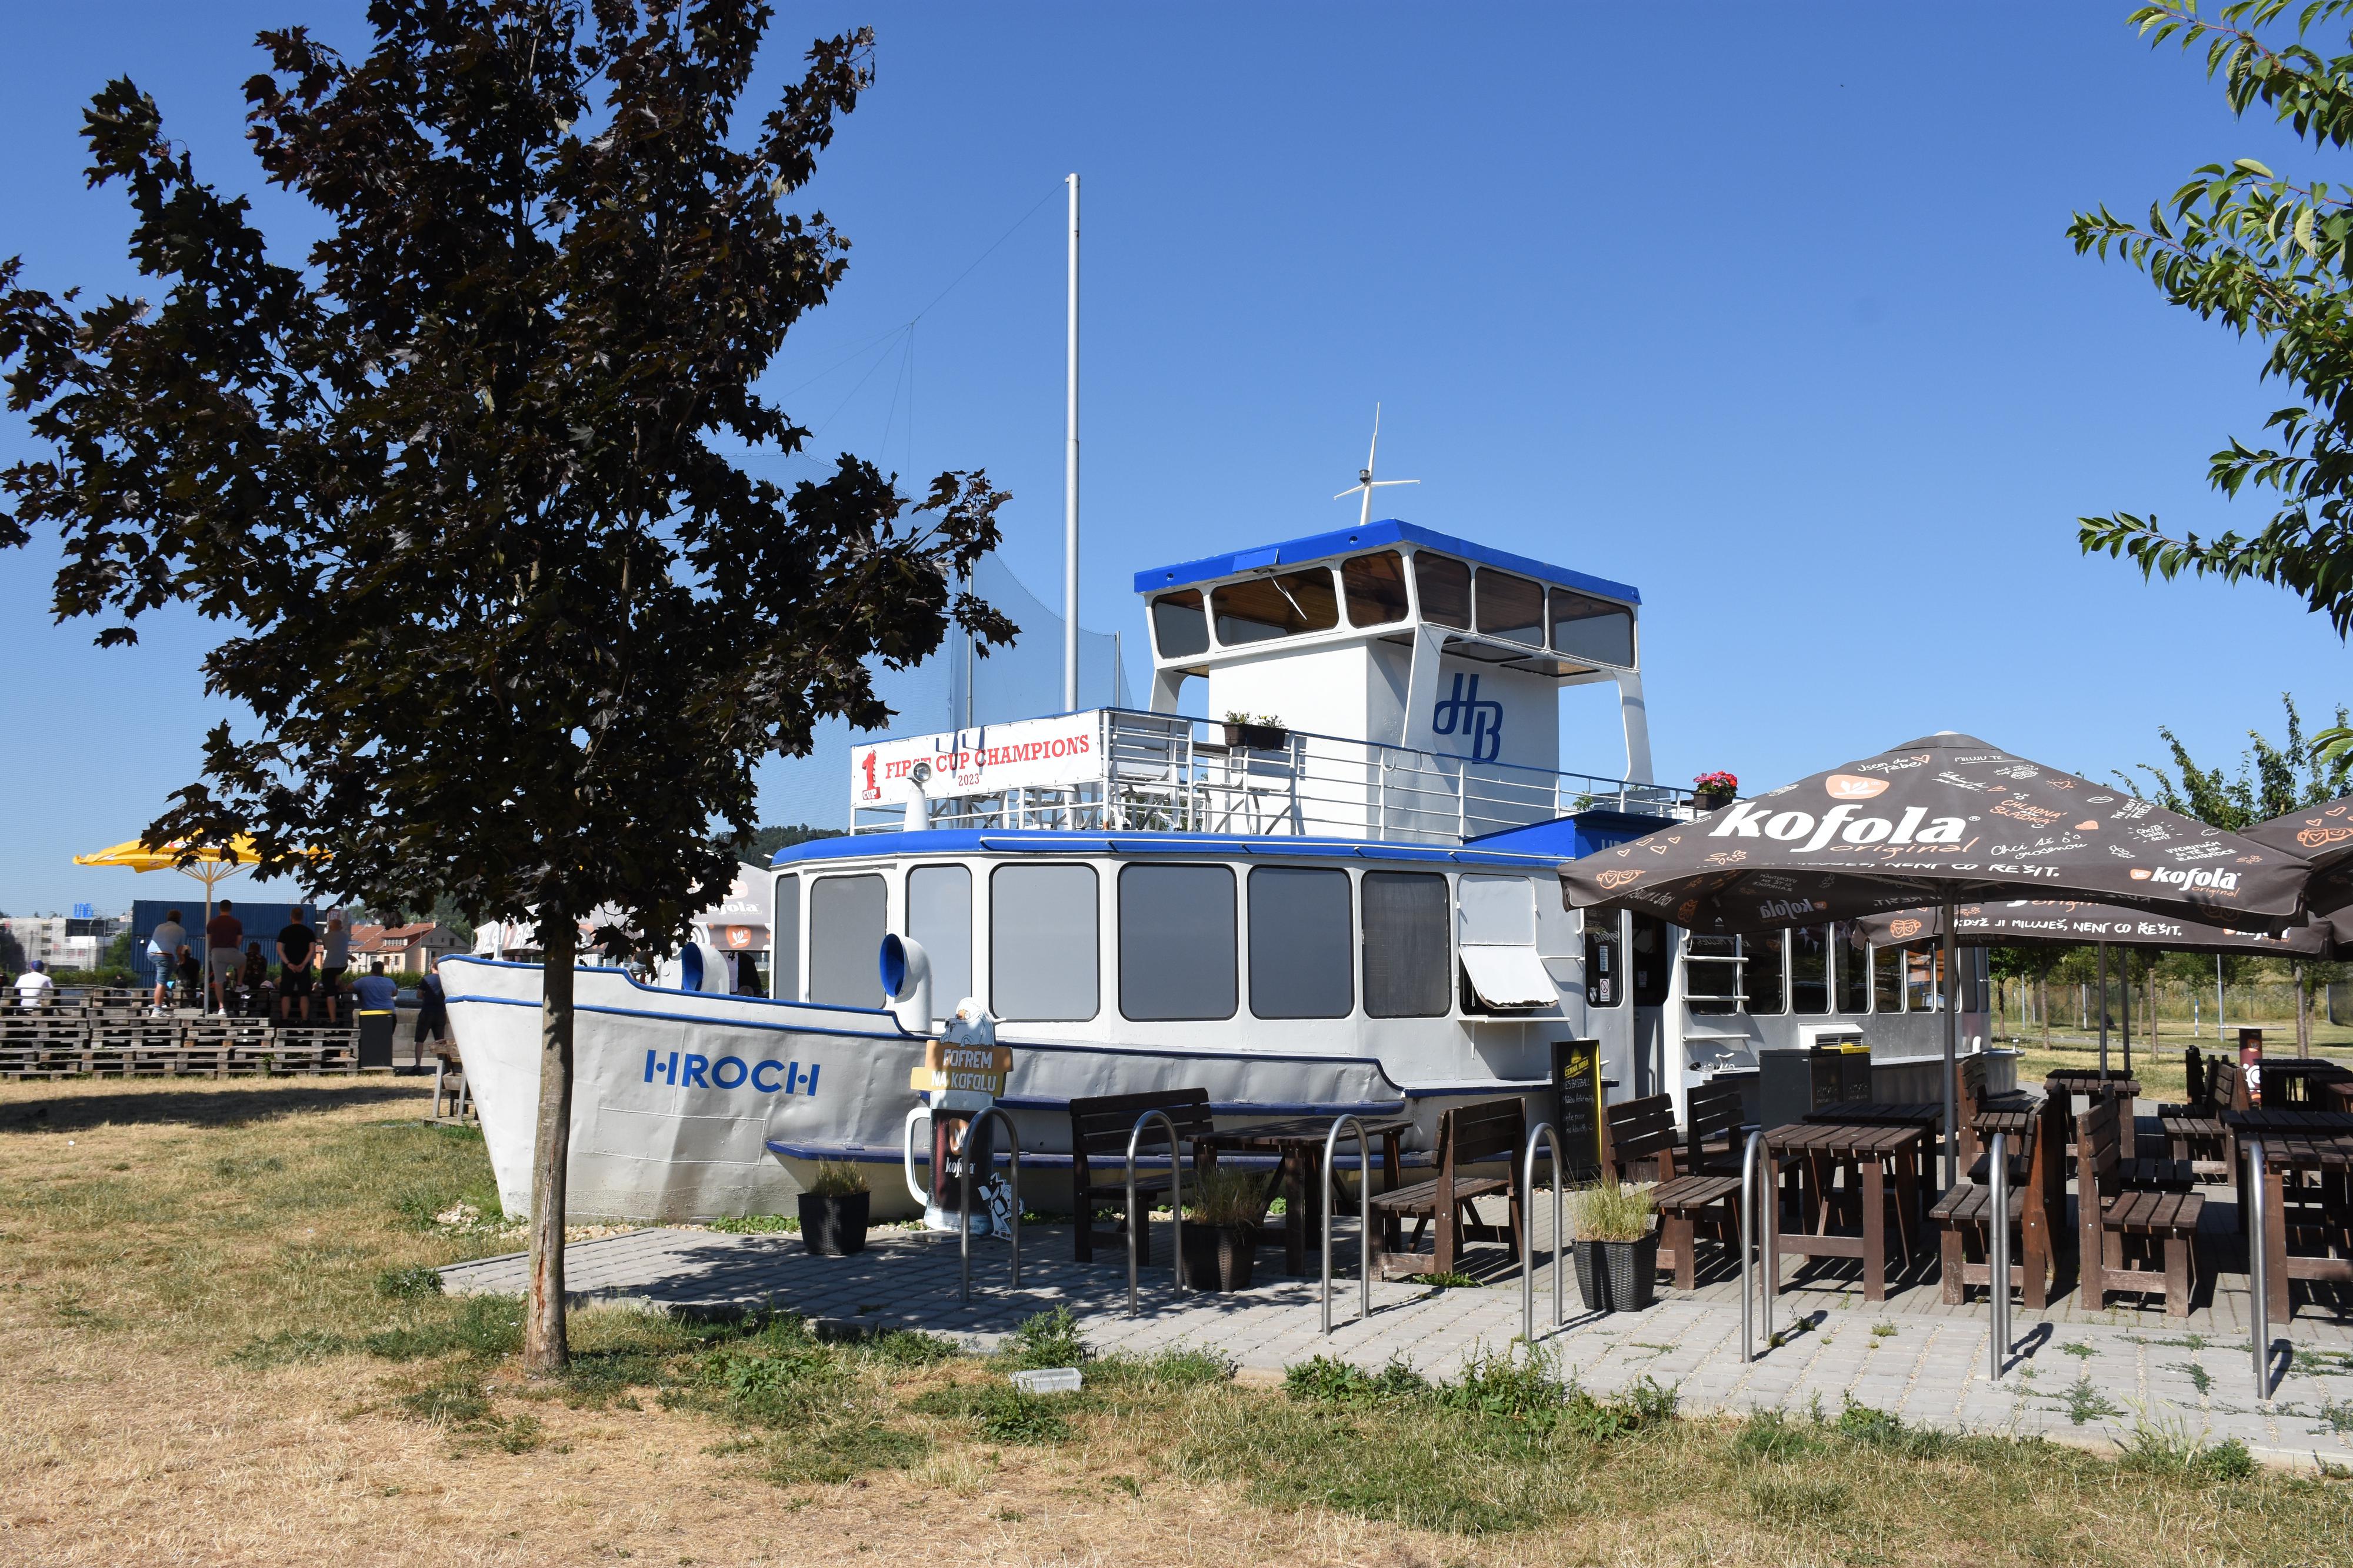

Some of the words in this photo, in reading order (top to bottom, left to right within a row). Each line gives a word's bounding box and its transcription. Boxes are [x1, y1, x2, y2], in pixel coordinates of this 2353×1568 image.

[936, 752, 969, 772] CUP
[975, 734, 1089, 766] CHAMPIONS
[1858, 762, 1888, 772] Jsem
[958, 775, 980, 786] 2023
[862, 789, 877, 800] CUP
[1989, 806, 2057, 825] SLADKÁ
[2001, 800, 2068, 818] CHLADNÁ
[2111, 809, 2127, 819] TVÁ
[2131, 804, 2155, 819] RTECH
[1708, 802, 1967, 852] kofola
[1829, 837, 1980, 860] original
[1991, 843, 2028, 855] Chci
[2165, 841, 2221, 853] VYCHUTNÁM
[1988, 864, 2059, 877] ŘEŠIT.
[2151, 867, 2238, 891] kofola
[2192, 887, 2241, 898] original
[706, 901, 759, 915] ofola
[1954, 918, 1989, 928] KDYŽ
[1995, 919, 2005, 928] JI
[2012, 919, 2068, 931] MILUJEŠ,
[2073, 922, 2111, 934] NENÍ
[2114, 923, 2132, 933] CO
[2138, 922, 2182, 936] ŘEŠIT.
[943, 1049, 993, 1069] FOFREM
[644, 1050, 821, 1096] HROCH
[931, 1072, 948, 1087] NA
[951, 1072, 997, 1092] KOFOLU
[945, 1157, 975, 1178] kofa
